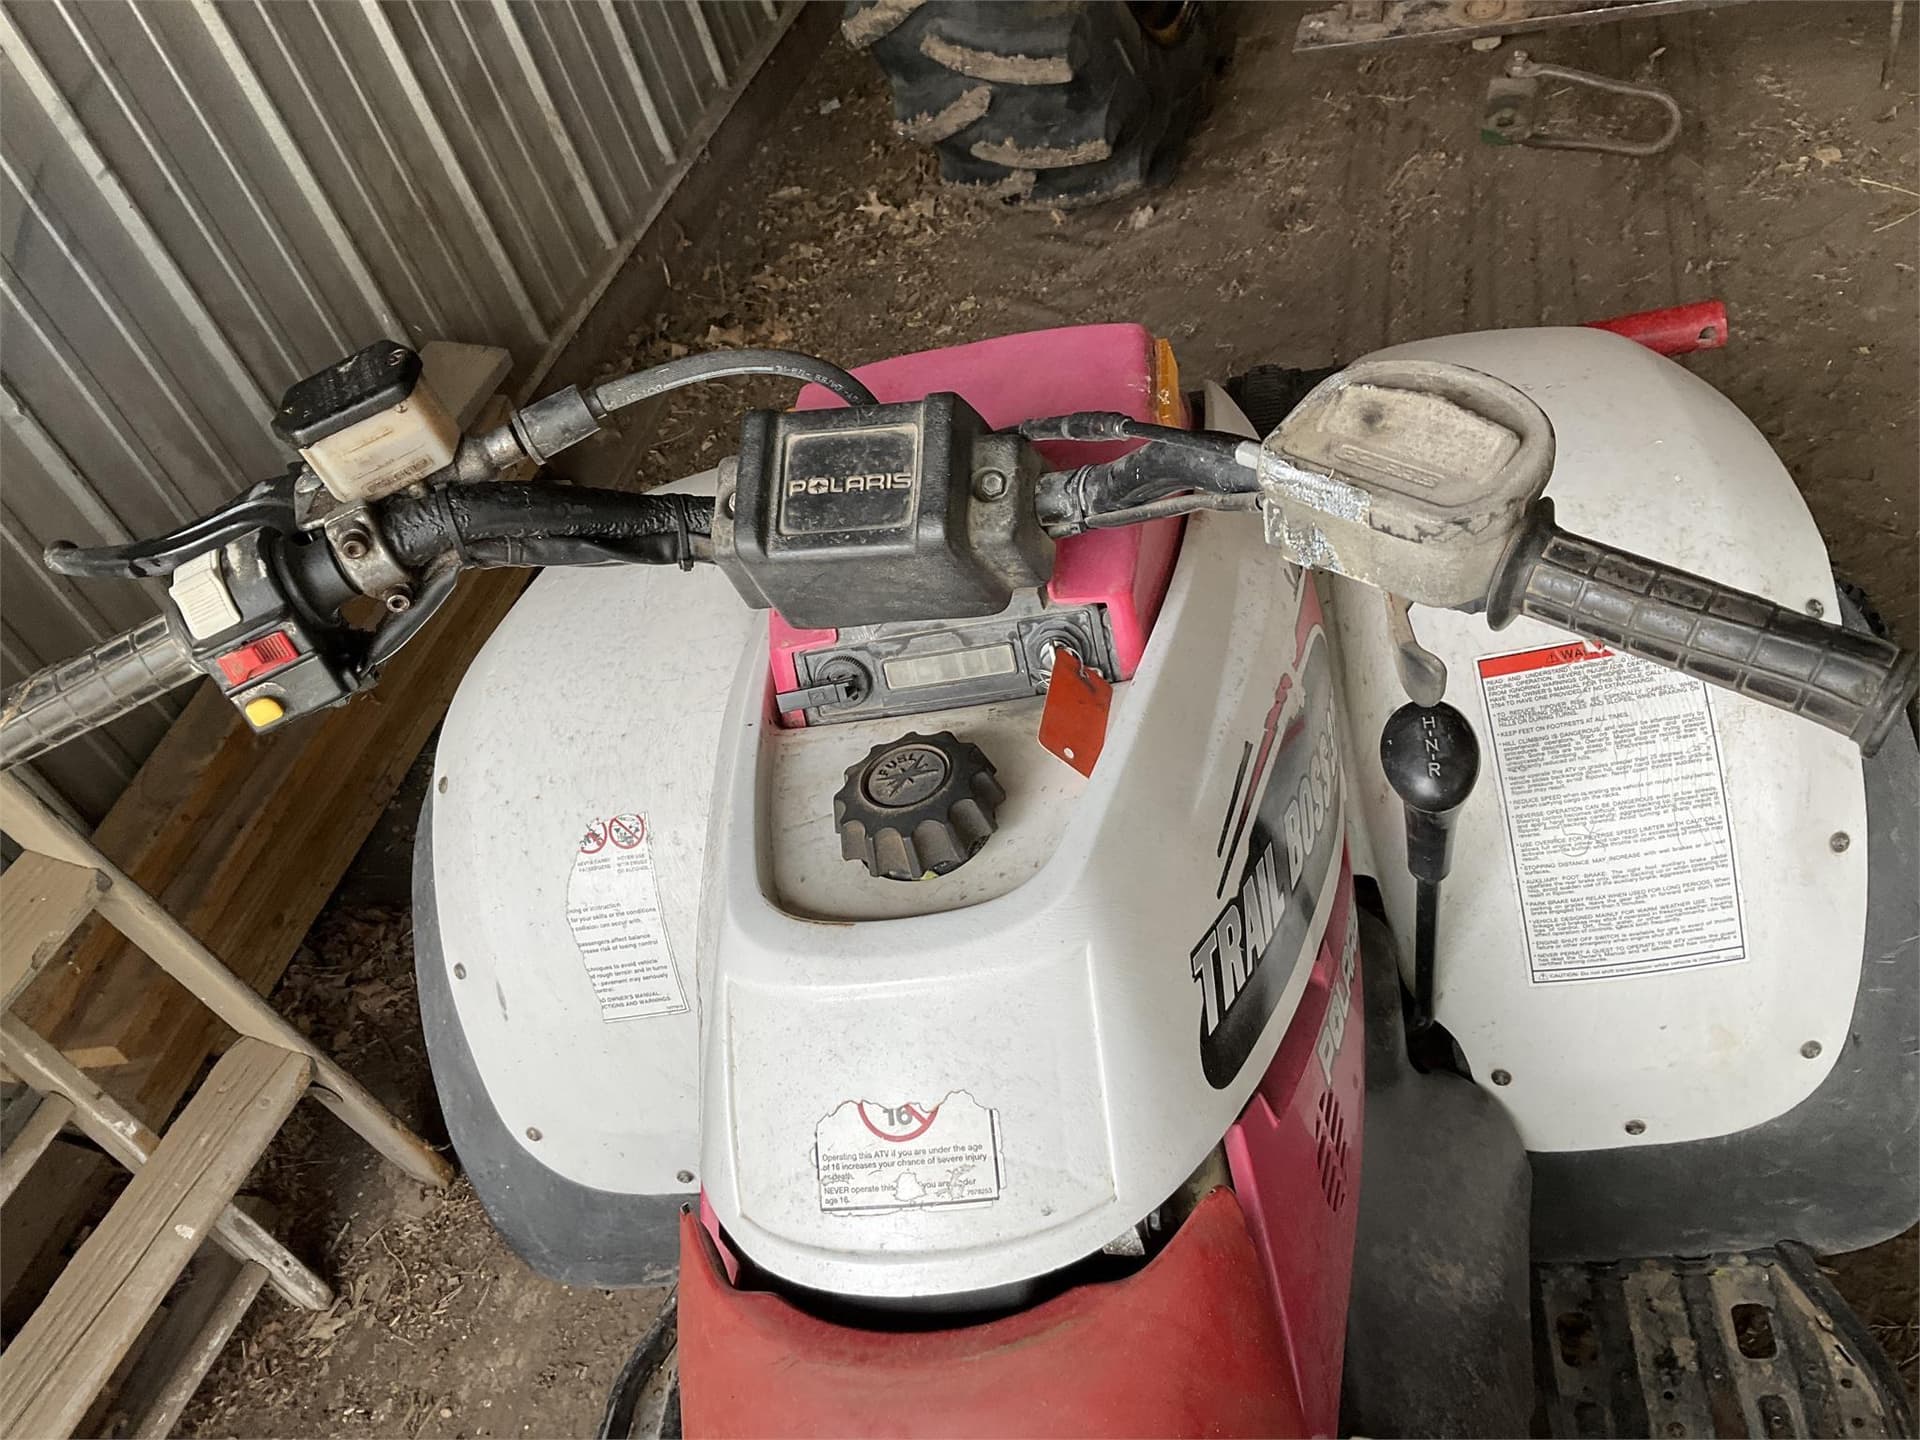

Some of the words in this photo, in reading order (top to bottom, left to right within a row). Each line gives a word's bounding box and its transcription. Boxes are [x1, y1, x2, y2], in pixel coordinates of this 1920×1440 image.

[787, 471, 912, 497] POLARIS
[1525, 667, 1568, 679] UNDERSTAND
[1487, 682, 1512, 691] BEFORE
[1557, 670, 1581, 679] SEVERE
[1509, 684, 1540, 694] IGNORING
[1542, 678, 1576, 688] WARNINGS
[1521, 688, 1552, 697] OWNER'S
[1553, 683, 1580, 692] MANUAL
[1549, 688, 1581, 698] PROVIDED
[1604, 681, 1625, 689] EXTRA
[1546, 719, 1584, 729] FOOTRESTS
[1192, 841, 1286, 1037] TRAIL
[1283, 733, 1332, 891] BOSS
[626, 907, 657, 916] conditions
[628, 933, 650, 941] balance
[619, 942, 637, 950] losing
[637, 958, 658, 966] vehicle
[601, 978, 627, 987] pavement
[629, 976, 641, 984] may
[642, 972, 669, 982] seriously
[822, 1152, 857, 1165] Operating
[858, 1151, 872, 1160] this
[874, 1150, 890, 1159] ATV
[898, 1150, 913, 1159] you
[914, 1148, 926, 1156] are
[928, 1145, 950, 1155] under
[953, 1144, 966, 1153] the
[968, 1144, 983, 1153] age
[842, 1160, 877, 1171] increases
[878, 1161, 895, 1170] your
[897, 1157, 926, 1168] chance
[927, 1156, 935, 1165] of
[938, 1155, 963, 1164] severe
[965, 1152, 987, 1163] injury
[824, 1185, 850, 1196] NEVER
[851, 1184, 879, 1195] operate
[881, 1182, 894, 1191] this
[923, 1182, 937, 1190] you
[825, 1198, 838, 1206] age
